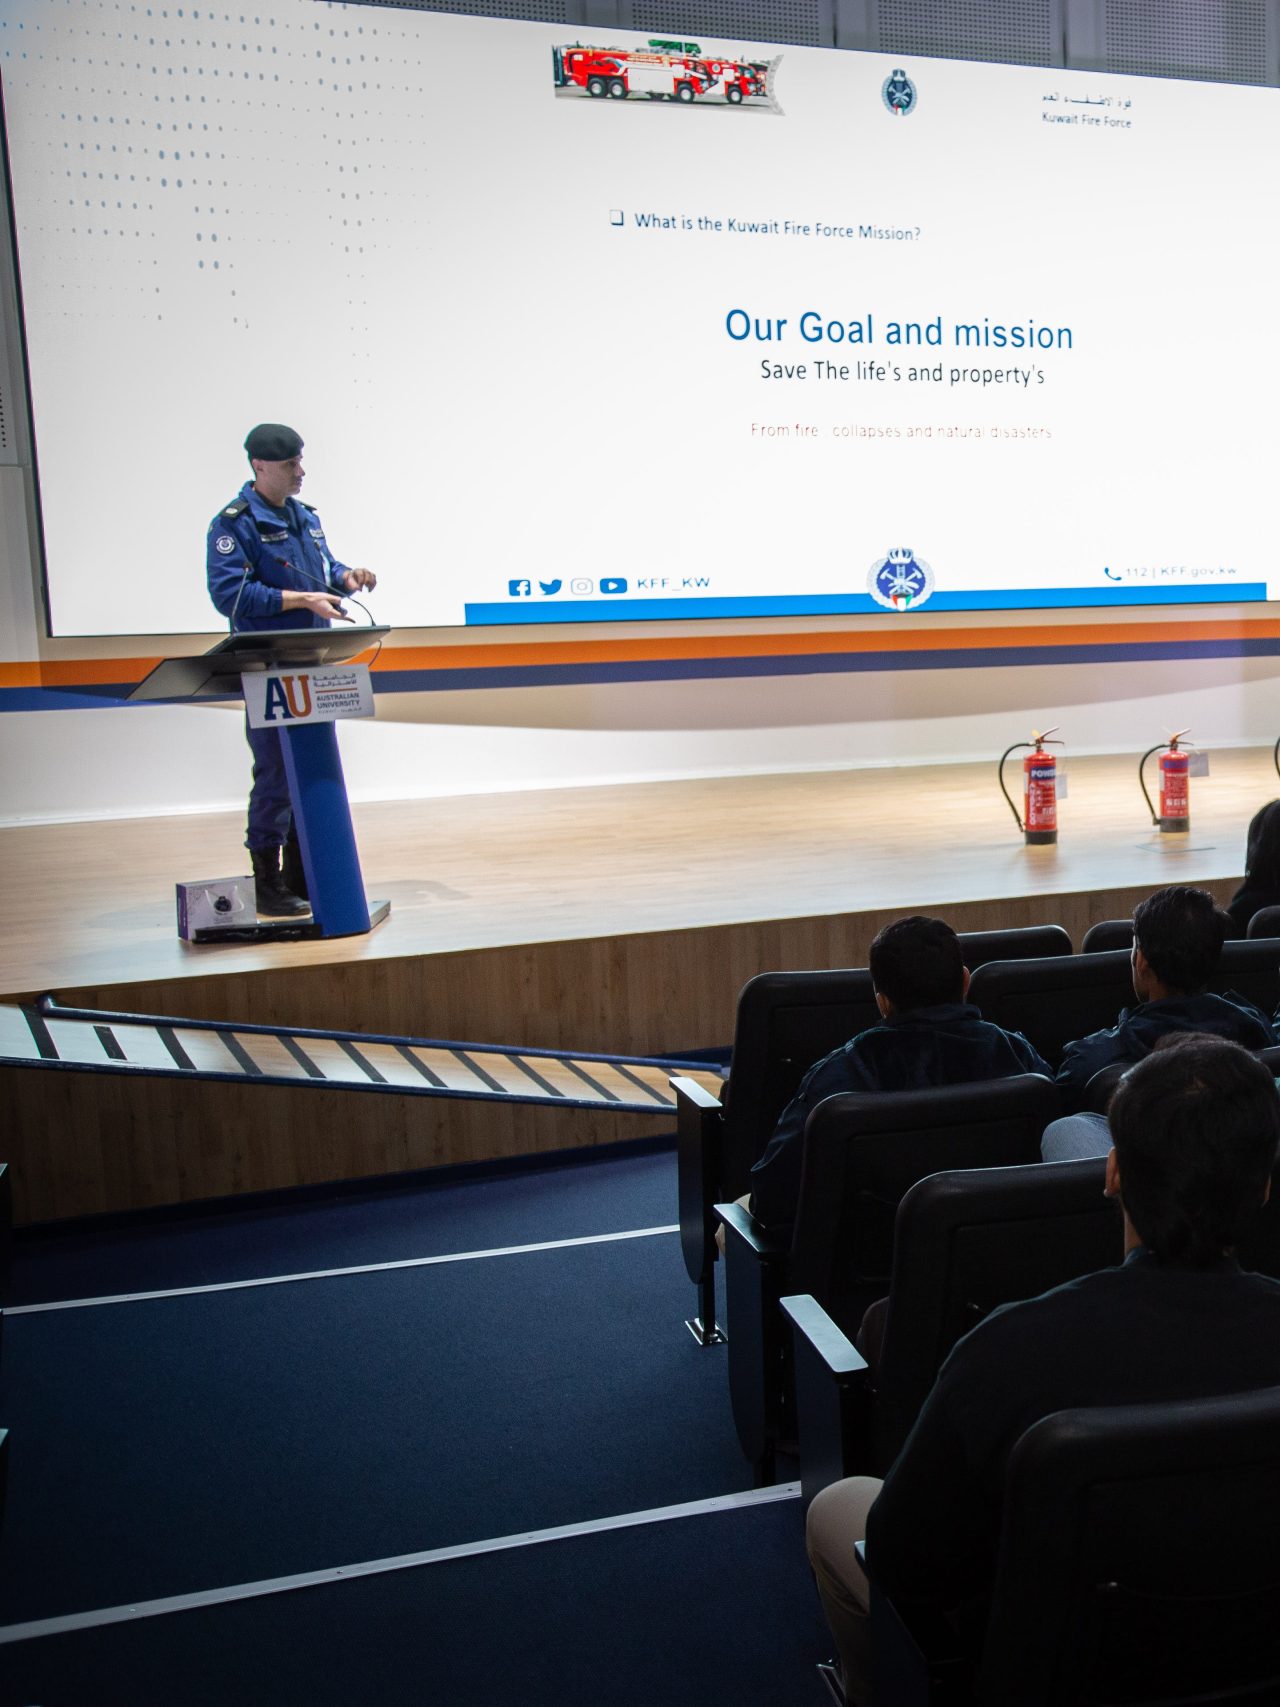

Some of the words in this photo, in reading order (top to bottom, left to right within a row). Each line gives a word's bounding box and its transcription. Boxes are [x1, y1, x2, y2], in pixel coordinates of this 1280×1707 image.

[1042, 112, 1078, 125] Kuwait
[1082, 114, 1100, 126] Fire
[1104, 116, 1132, 128] Force
[634, 213, 676, 229] What
[681, 215, 693, 230] is
[698, 216, 723, 232] the
[728, 218, 779, 234] Kuwait
[784, 221, 810, 236] Fire
[816, 223, 853, 237] Force
[859, 224, 921, 240] Mission?
[725, 309, 788, 342] Our
[800, 312, 873, 345] Goal
[886, 317, 943, 346] and
[955, 318, 1073, 349] mission
[761, 359, 807, 381] Save
[814, 361, 850, 381] The
[857, 361, 901, 382] life's
[908, 363, 943, 383] and
[950, 364, 1045, 387] property's
[752, 423, 789, 437] From
[796, 423, 818, 437] fire
[832, 424, 901, 439] collapses
[907, 426, 932, 438] and
[938, 424, 986, 438] natural
[991, 425, 1052, 439] disasters
[1126, 567, 1147, 577] 112
[1161, 566, 1237, 578] KFF.gov.kw
[638, 577, 710, 592] KFF_KW
[264, 674, 312, 721] AU
[316, 692, 360, 702] AUSTRALIAN
[316, 699, 361, 709] UNIVERSITY
